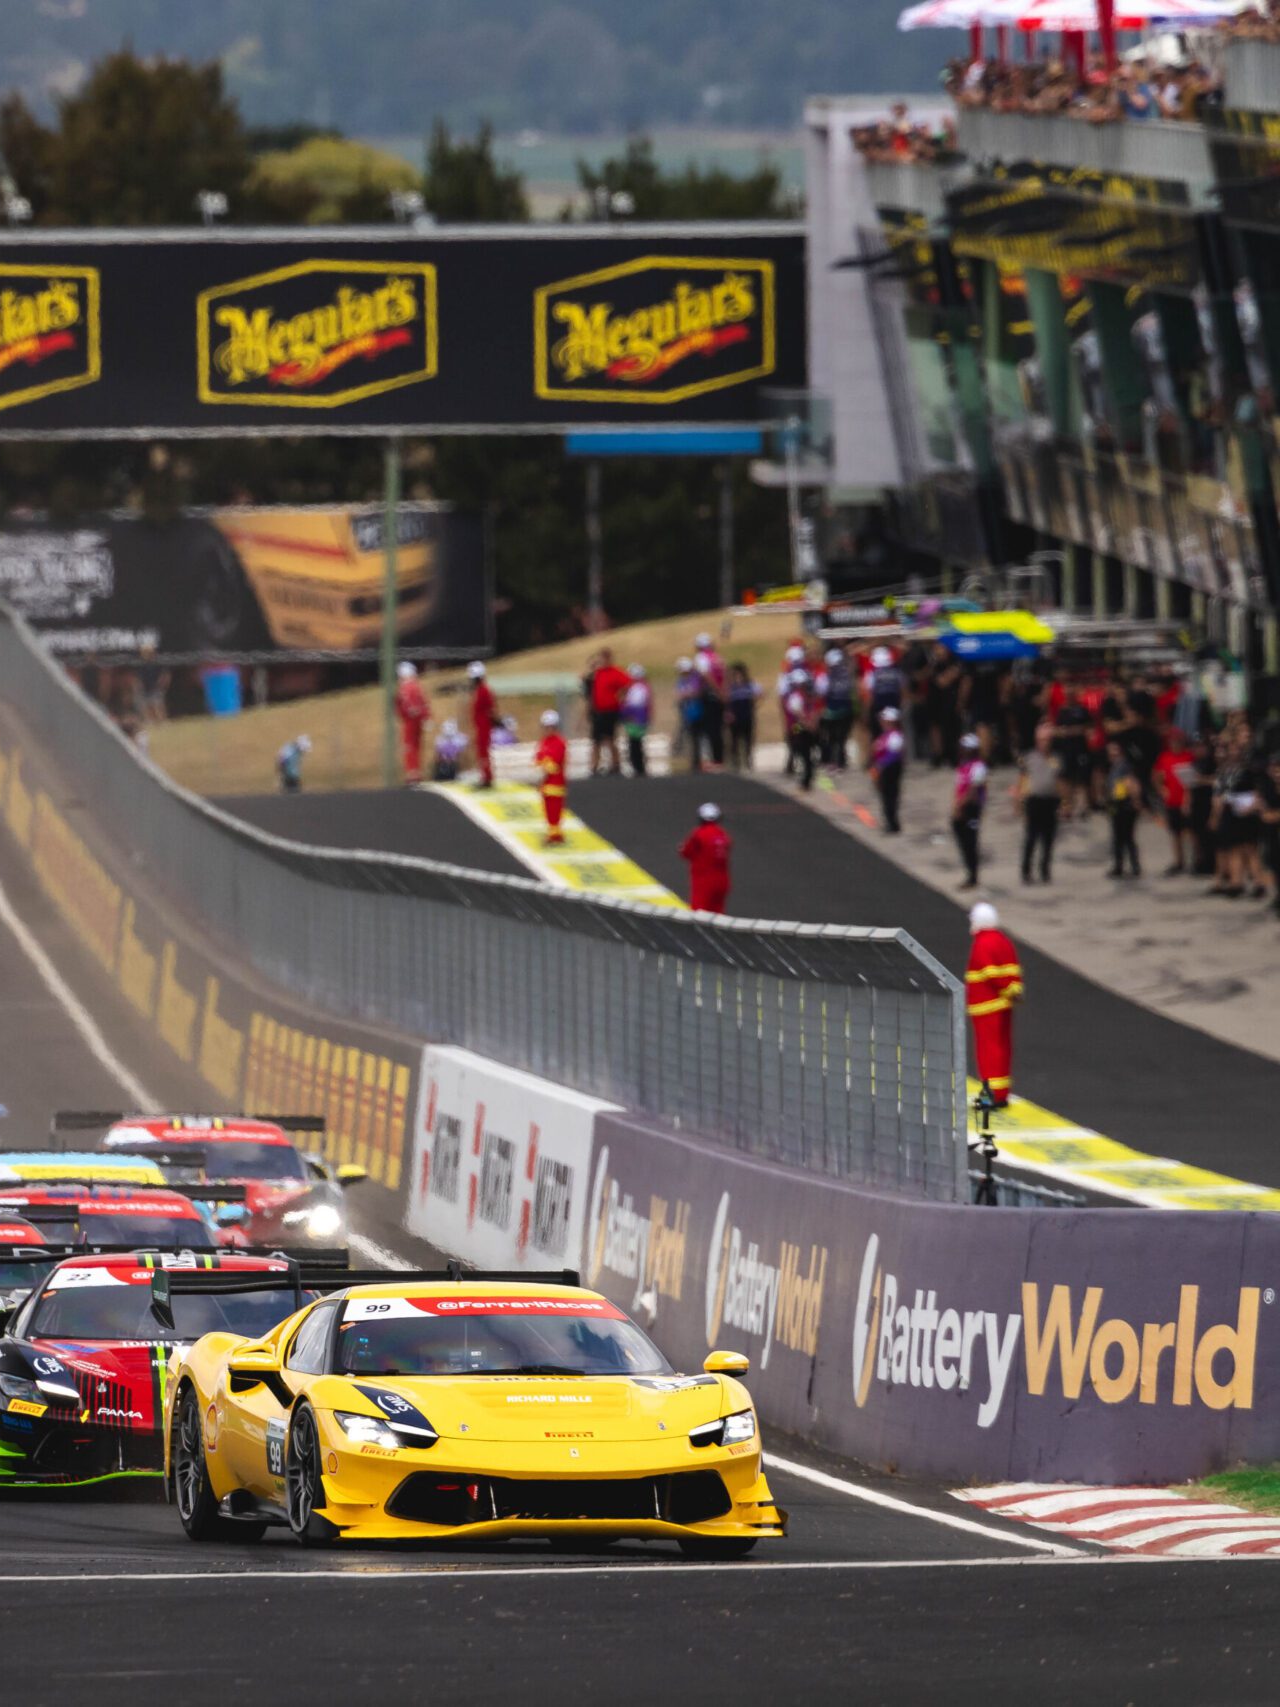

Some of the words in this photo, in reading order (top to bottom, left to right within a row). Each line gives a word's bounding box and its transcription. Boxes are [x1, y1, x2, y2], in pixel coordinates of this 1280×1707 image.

[215, 275, 417, 386] Meguiar's
[553, 271, 755, 383] Meguiar's
[66, 1272, 92, 1281] 22
[365, 1303, 392, 1313] 99
[436, 1299, 604, 1311] @FerrariRaces
[877, 1273, 1021, 1428] Battery
[1022, 1282, 1261, 1409] World
[385, 1395, 414, 1412] aws
[506, 1394, 556, 1403] RICHARD
[559, 1394, 593, 1403] MILLE
[544, 1431, 594, 1439] PIRELLI
[270, 1441, 281, 1474] 99
